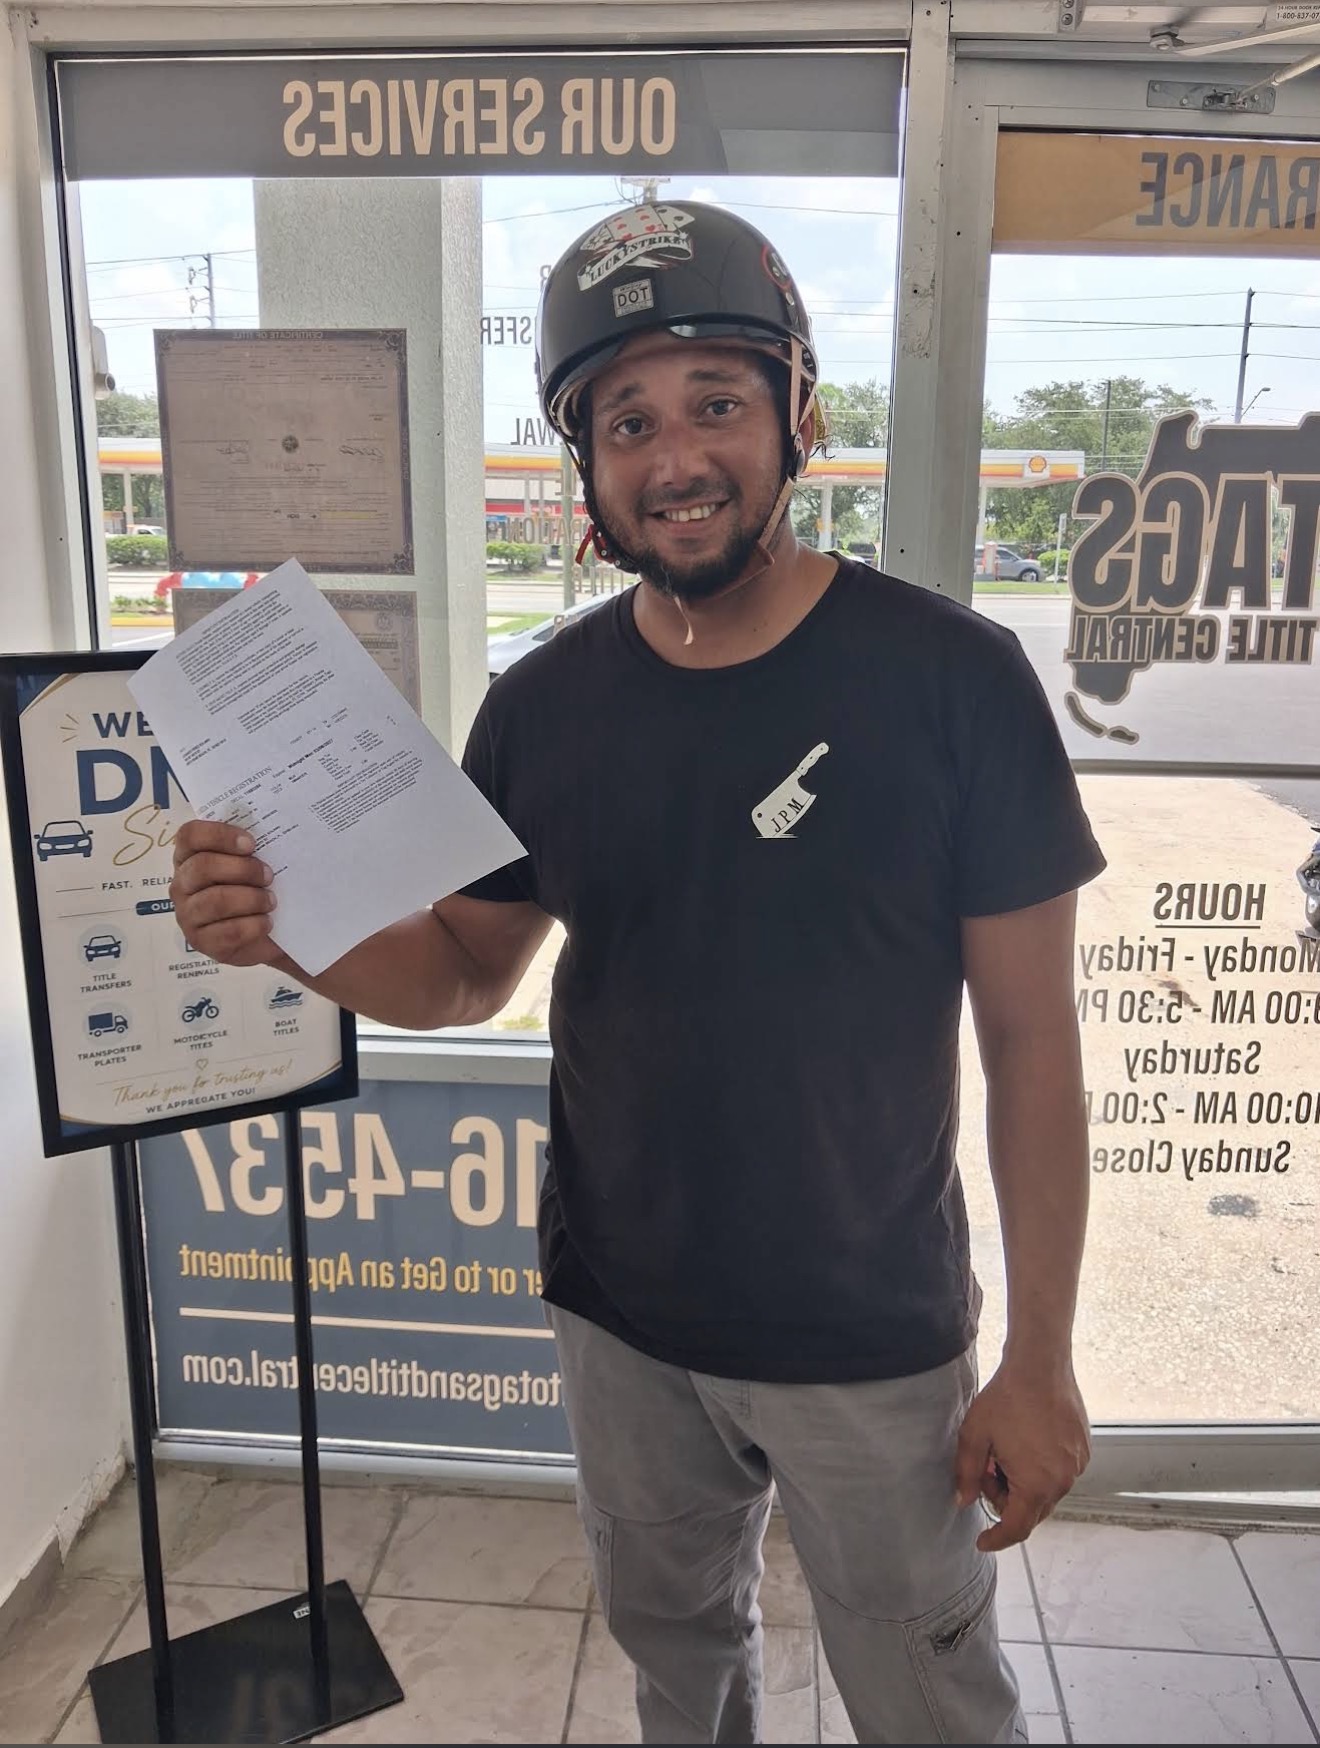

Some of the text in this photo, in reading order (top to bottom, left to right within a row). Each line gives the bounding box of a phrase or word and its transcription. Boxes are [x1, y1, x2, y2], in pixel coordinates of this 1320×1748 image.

[616, 286, 647, 306] DOT
[228, 765, 272, 795] REGISTRATION
[102, 881, 133, 890] FAST.
[93, 972, 116, 982] TITLE
[80, 980, 132, 993] TRANSFERS
[275, 1018, 297, 1028] BOAT
[273, 1026, 300, 1037] TITLES
[77, 1044, 142, 1061] TRANSPORTER
[94, 1056, 127, 1067] PLATES
[112, 1082, 159, 1107] Thank
[161, 1085, 187, 1103] you
[213, 1067, 267, 1086] trusting
[145, 1105, 164, 1114] WE
[230, 1087, 256, 1098] YOU!
